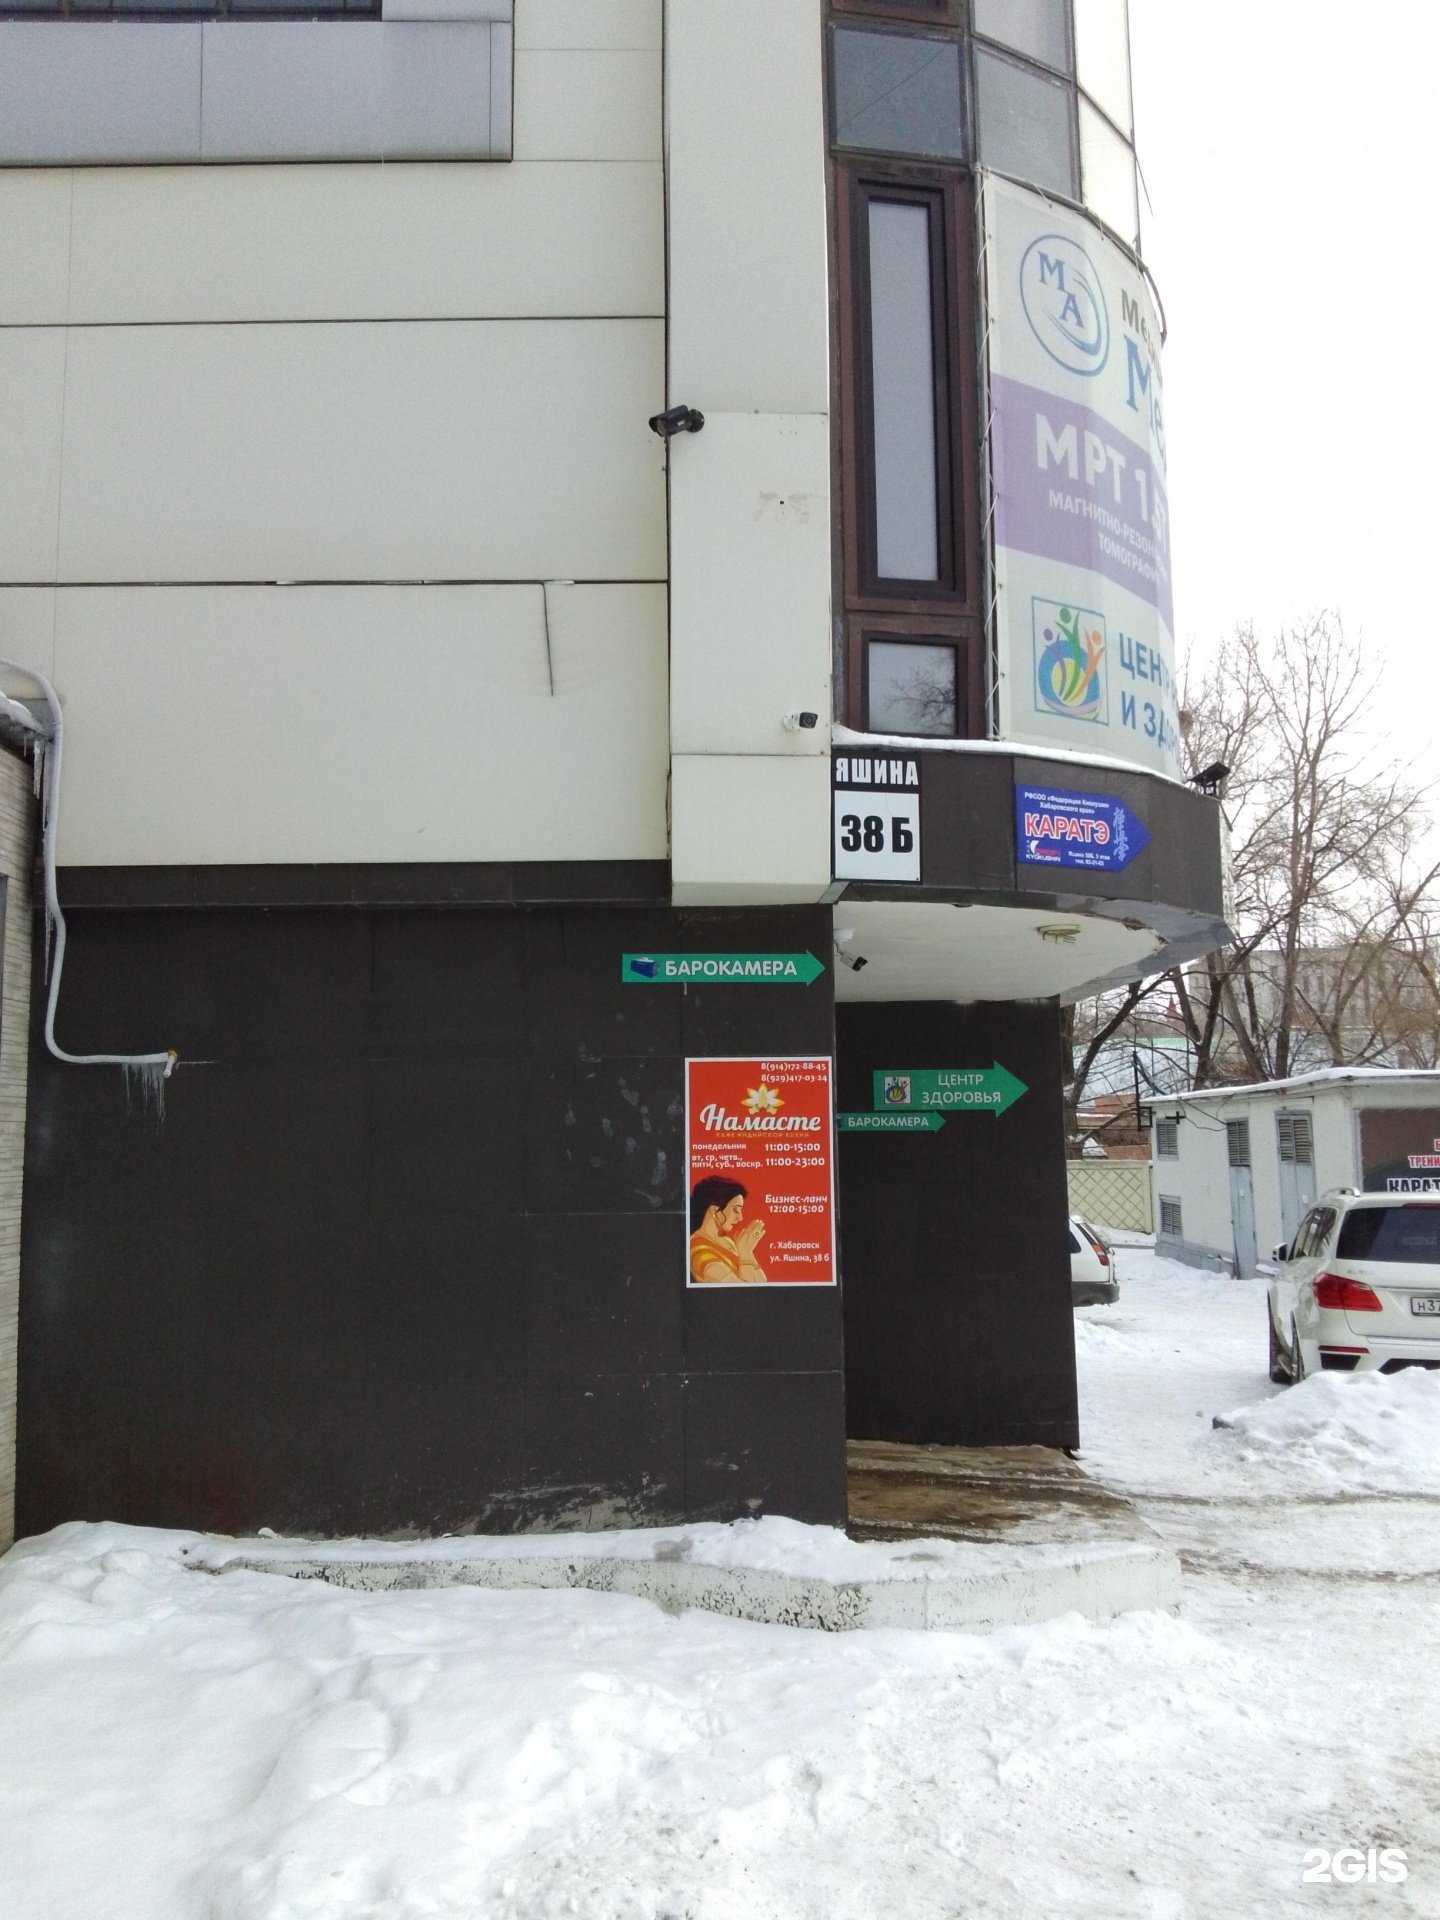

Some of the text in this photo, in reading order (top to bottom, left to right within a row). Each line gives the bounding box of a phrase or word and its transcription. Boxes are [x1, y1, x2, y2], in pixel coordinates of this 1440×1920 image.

[1036, 413, 1127, 504] МРТ
[1121, 690, 1136, 730] И
[836, 758, 919, 785] ЯШИНА
[841, 815, 913, 853] 38 Б
[1024, 812, 1110, 845] КАРАТЭ
[665, 961, 798, 976] БАРОКАМЕРА
[938, 1074, 985, 1087] ЦЕНТР
[922, 1091, 1002, 1105] ЗДОРОВЬЯ
[700, 1104, 821, 1131] Намасте
[848, 1117, 929, 1127] БАРОКАМЕРА
[765, 1143, 821, 1152] 11:00-15:00
[766, 1157, 825, 1168] 11:00-23:00
[765, 1194, 828, 1204] Бизнес-ланч
[769, 1205, 824, 1214] 12:00-15:00
[778, 1241, 820, 1251] Хабаровск
